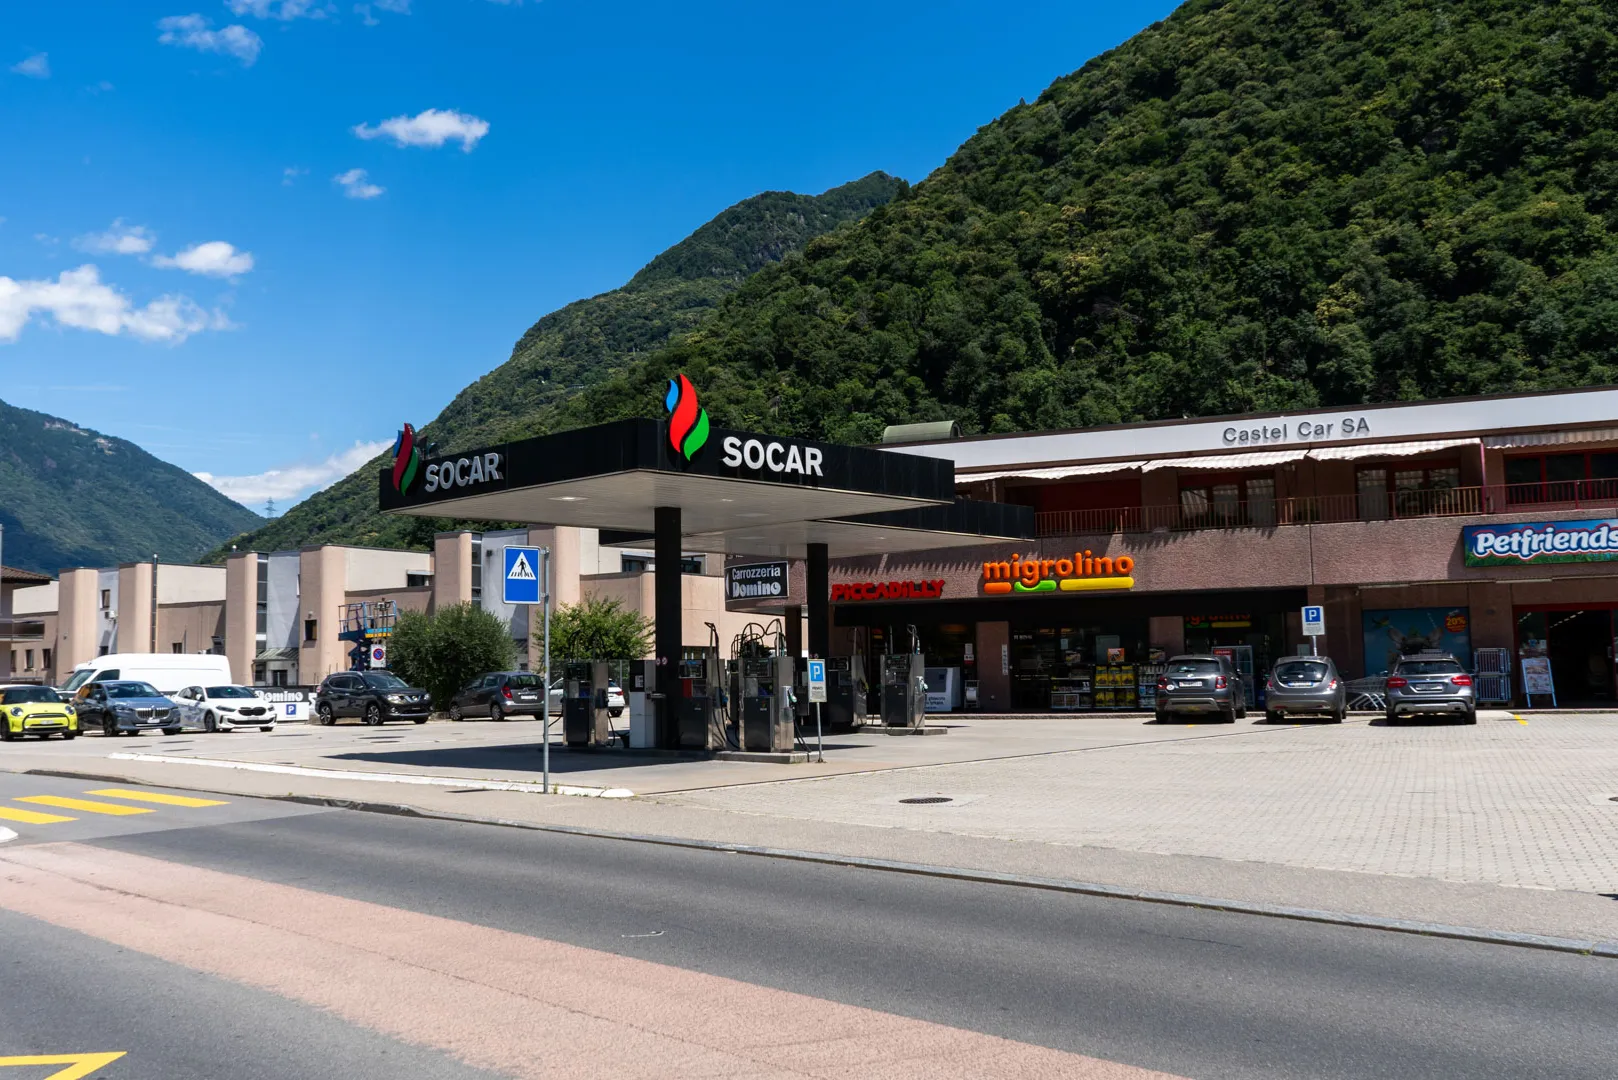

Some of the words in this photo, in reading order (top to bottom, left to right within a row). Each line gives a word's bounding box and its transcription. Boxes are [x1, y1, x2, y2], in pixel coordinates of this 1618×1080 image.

[1223, 424, 1288, 443] Castel
[1297, 421, 1334, 438] Car
[1341, 417, 1370, 434] SA
[722, 436, 824, 477] SOCAR
[425, 452, 503, 493] SOCAR
[1476, 526, 1618, 556] Petfriends
[732, 565, 781, 580] Carrozzeria
[983, 550, 1135, 587] migrolino
[733, 580, 781, 597] Domino
